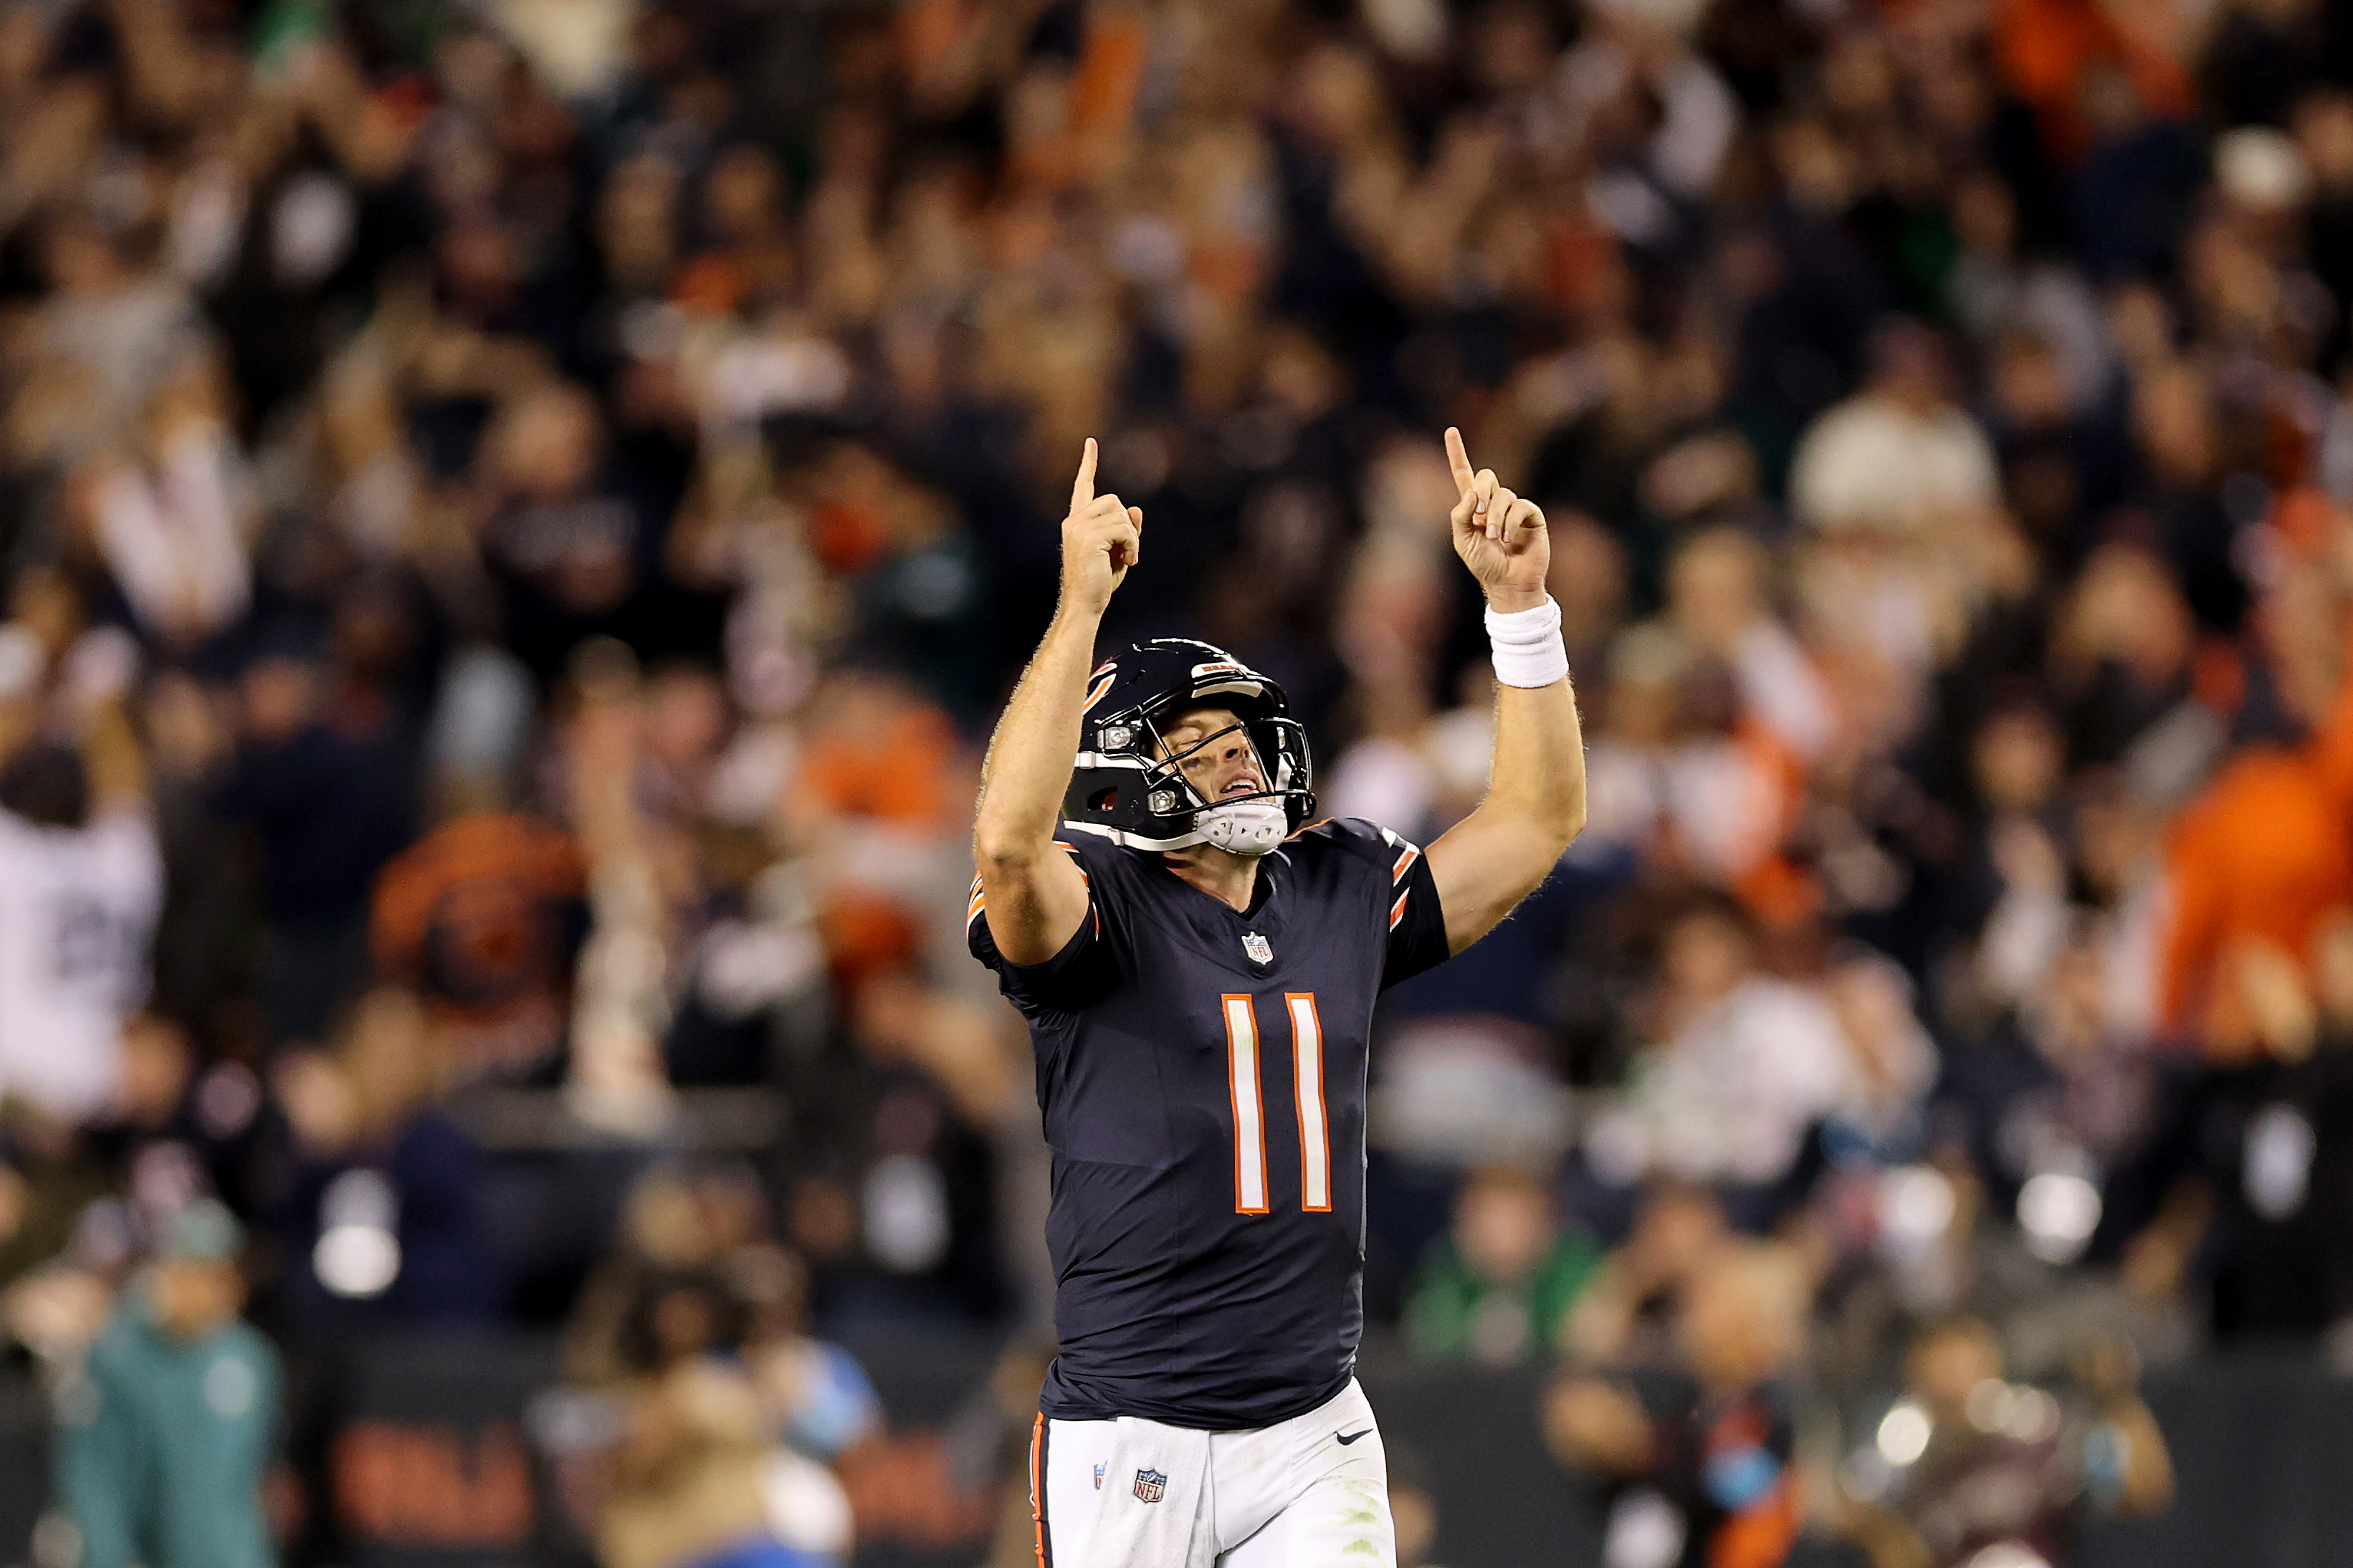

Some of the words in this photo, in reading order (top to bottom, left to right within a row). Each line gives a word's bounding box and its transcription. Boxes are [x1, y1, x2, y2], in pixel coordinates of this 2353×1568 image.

[1251, 946, 1269, 958] NFL
[1221, 992, 1332, 1214] 11
[1137, 1481, 1160, 1501] NFL
